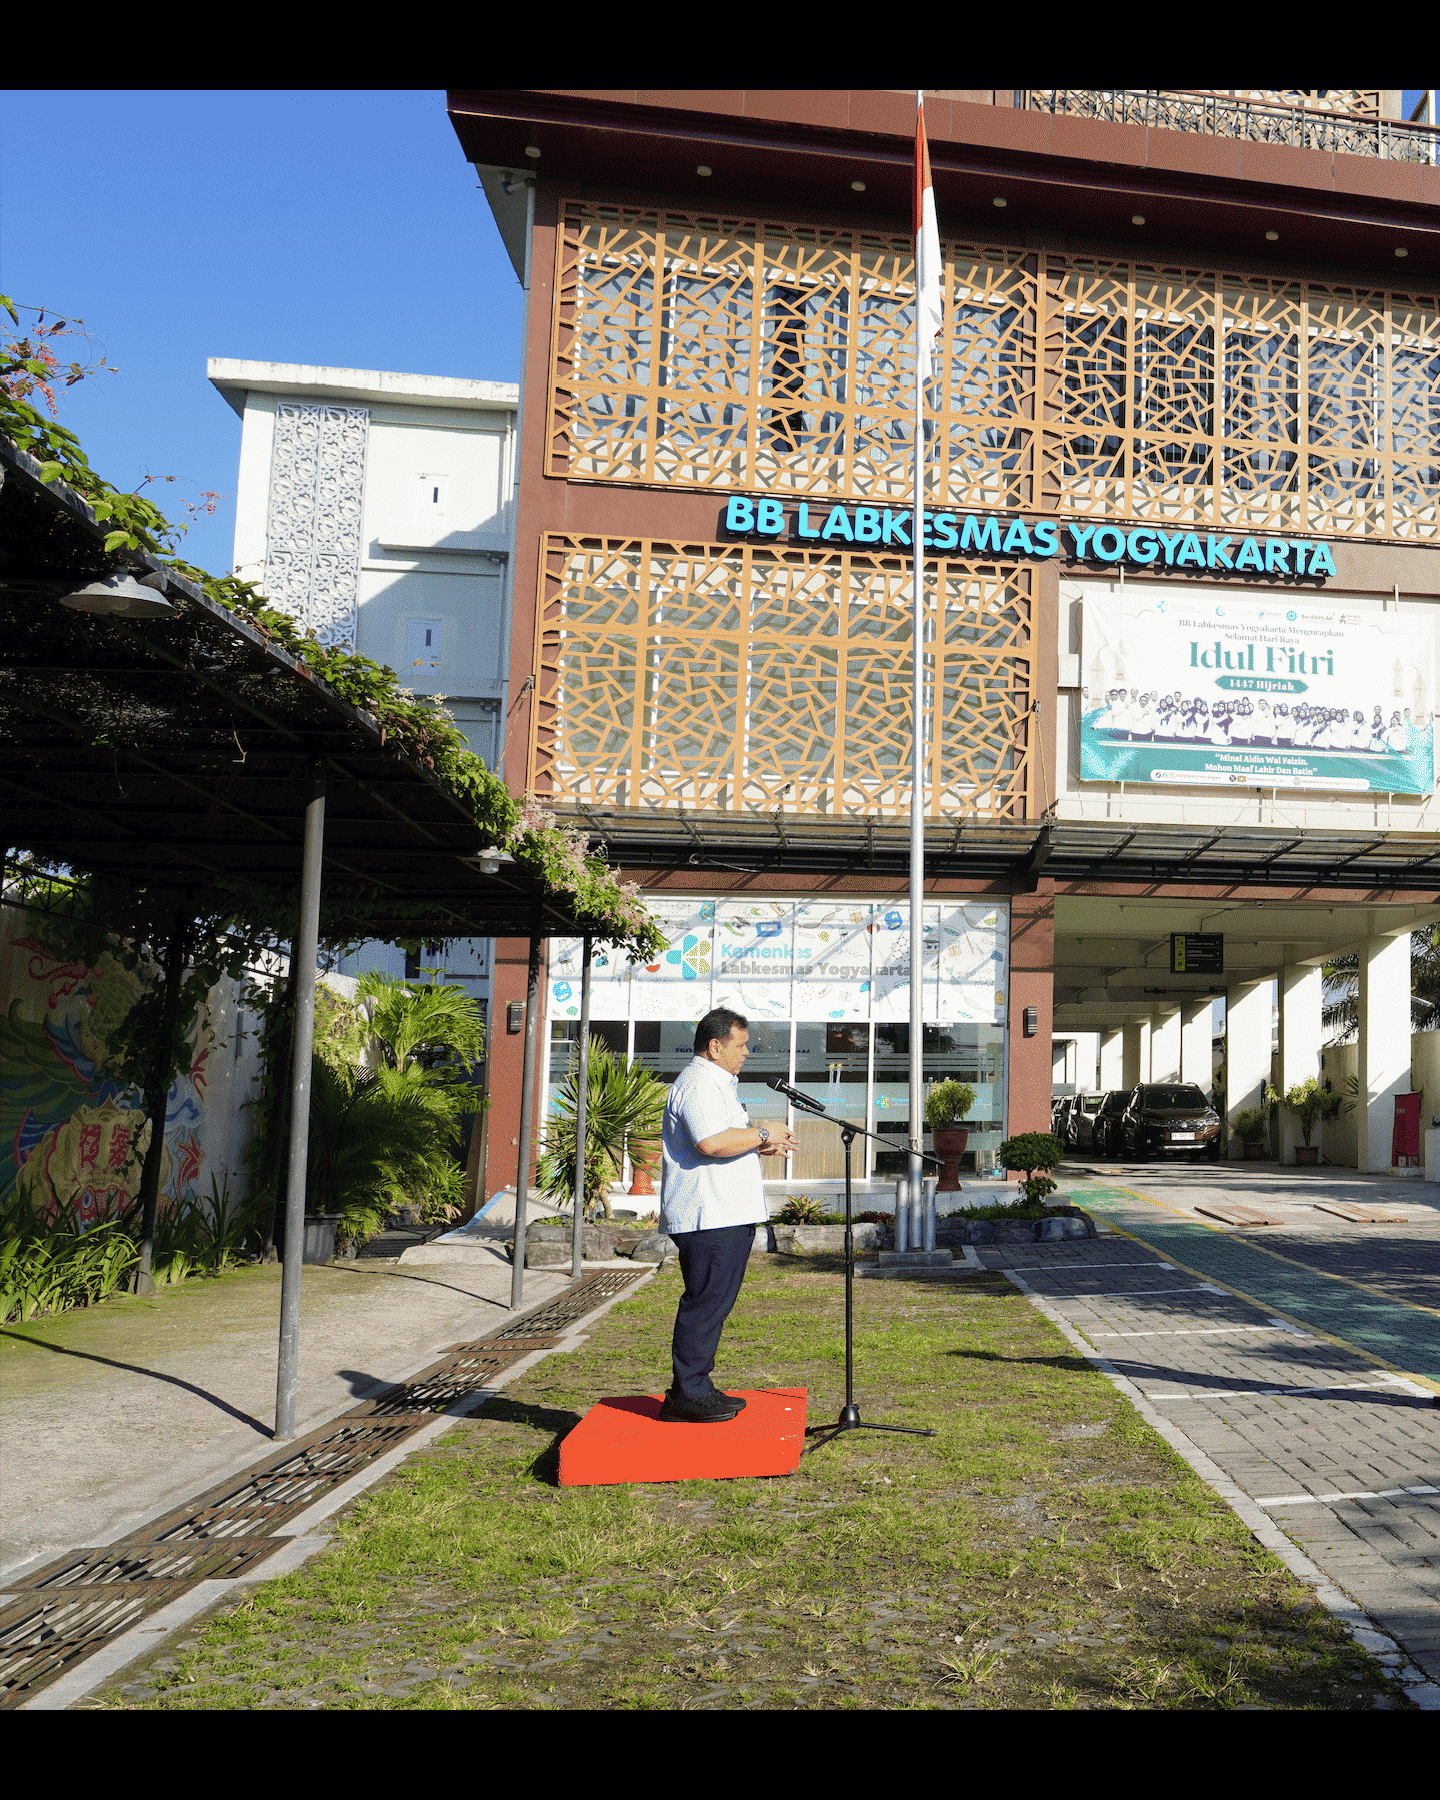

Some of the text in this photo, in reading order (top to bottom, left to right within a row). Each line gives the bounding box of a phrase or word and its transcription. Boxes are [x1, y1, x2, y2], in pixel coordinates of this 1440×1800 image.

[725, 496, 1337, 577] BB LABKESMAS YOGYAKARTA
[1193, 620, 1239, 630] Labkesmas
[1240, 624, 1286, 633] Yogyakarta
[1288, 626, 1345, 638] Mengucapkan
[1224, 632, 1300, 645] Selamat Hari Raya
[1190, 641, 1335, 676] Idul Fitri
[1230, 678, 1294, 692] 1447 Hijriah
[1243, 754, 1264, 764] Aidin
[1265, 755, 1281, 765] Wal
[1205, 763, 1232, 772] Mohon
[1233, 764, 1254, 773] Maaf
[1254, 764, 1275, 774] Lahir
[1275, 766, 1291, 775] Dan
[721, 960, 813, 976] Labkesmas
